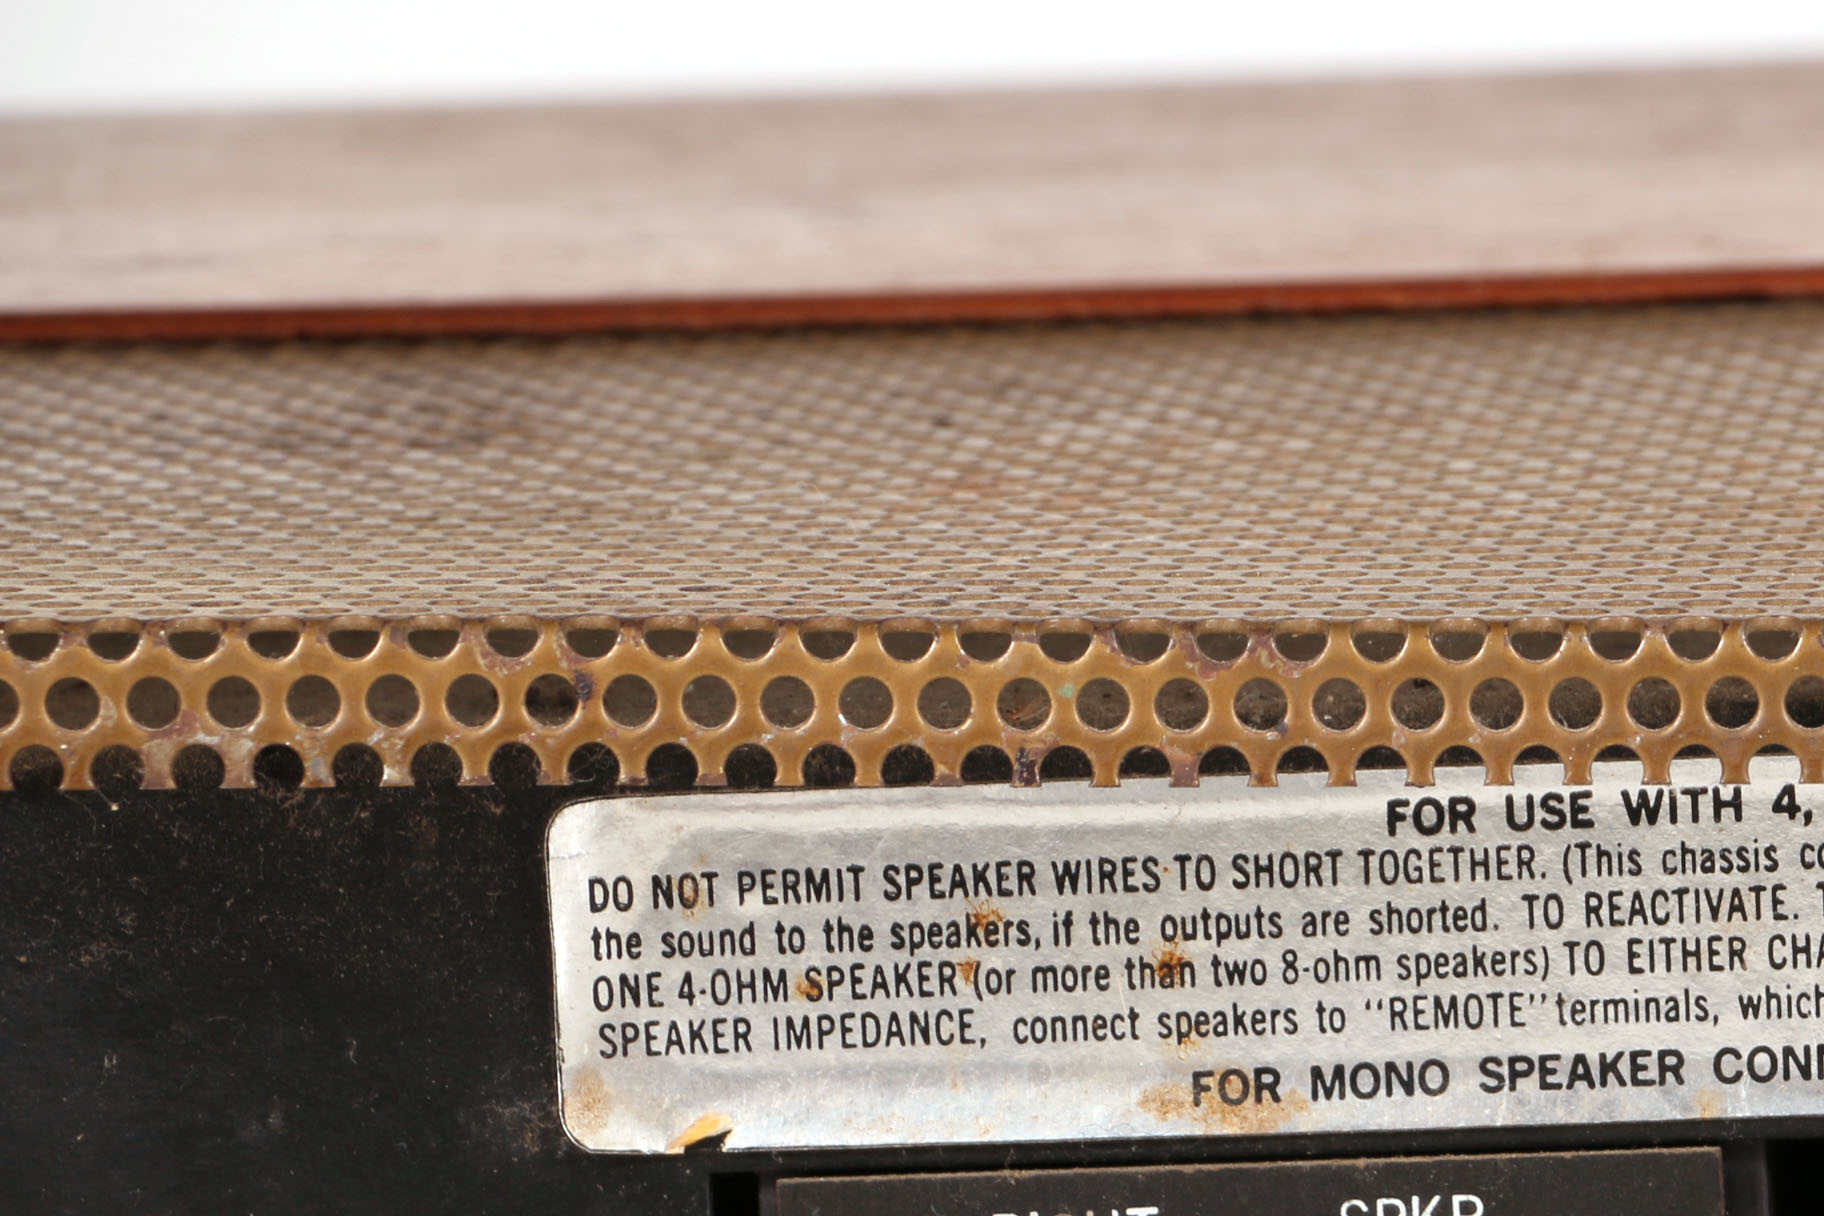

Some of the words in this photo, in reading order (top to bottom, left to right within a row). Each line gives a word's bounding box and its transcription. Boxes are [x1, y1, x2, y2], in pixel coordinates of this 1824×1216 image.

[1386, 796, 1477, 837] FOR
[1505, 790, 1595, 832] USE
[1620, 786, 1743, 827] WITH
[1771, 784, 1813, 827] 4,
[588, 876, 634, 913] DO
[651, 871, 719, 910] NOT
[737, 864, 865, 906] PERMIT
[882, 859, 1037, 902] SPEAKER
[1051, 855, 1161, 896] WIRES
[1173, 853, 1216, 892] TO
[1231, 849, 1343, 890] SHORT
[1356, 844, 1546, 886] TOGETHER.
[1562, 841, 1643, 885] (This
[1662, 841, 1779, 876] chassis
[591, 927, 642, 961] the
[661, 921, 756, 959] sound
[774, 920, 806, 955] to
[822, 916, 874, 954] the
[890, 911, 1041, 957] speakers,
[1052, 910, 1074, 947] if
[1088, 910, 1140, 946] the
[1160, 905, 1283, 948] outputs
[1301, 910, 1350, 938] are
[1369, 897, 1499, 936] shorted.
[1521, 893, 1564, 930] TO
[1584, 883, 1799, 928] REACTIVATE.
[593, 971, 664, 1012] ONE
[678, 967, 789, 1006] 4-OHM
[804, 960, 958, 1003] SPEAKER
[973, 961, 1016, 1002] (or
[1031, 965, 1110, 994] more
[1124, 955, 1196, 991] than
[1210, 954, 1267, 988] two
[1281, 949, 1381, 985] 8-ohm
[1396, 945, 1550, 987] speakers)
[1562, 939, 1605, 976] TO
[1627, 935, 1747, 975] EITHER
[598, 1017, 752, 1059] SPEAKER
[773, 1008, 986, 1051] IMPEDANCE,
[1013, 1007, 1140, 1045] connect
[1157, 1002, 1298, 1046] speakers
[1315, 1001, 1346, 1034] to
[1555, 988, 1719, 1026] terminals,
[1192, 1066, 1281, 1107] FOR
[1310, 1058, 1450, 1102] MONO
[1478, 1049, 1685, 1094] SPEAKER
